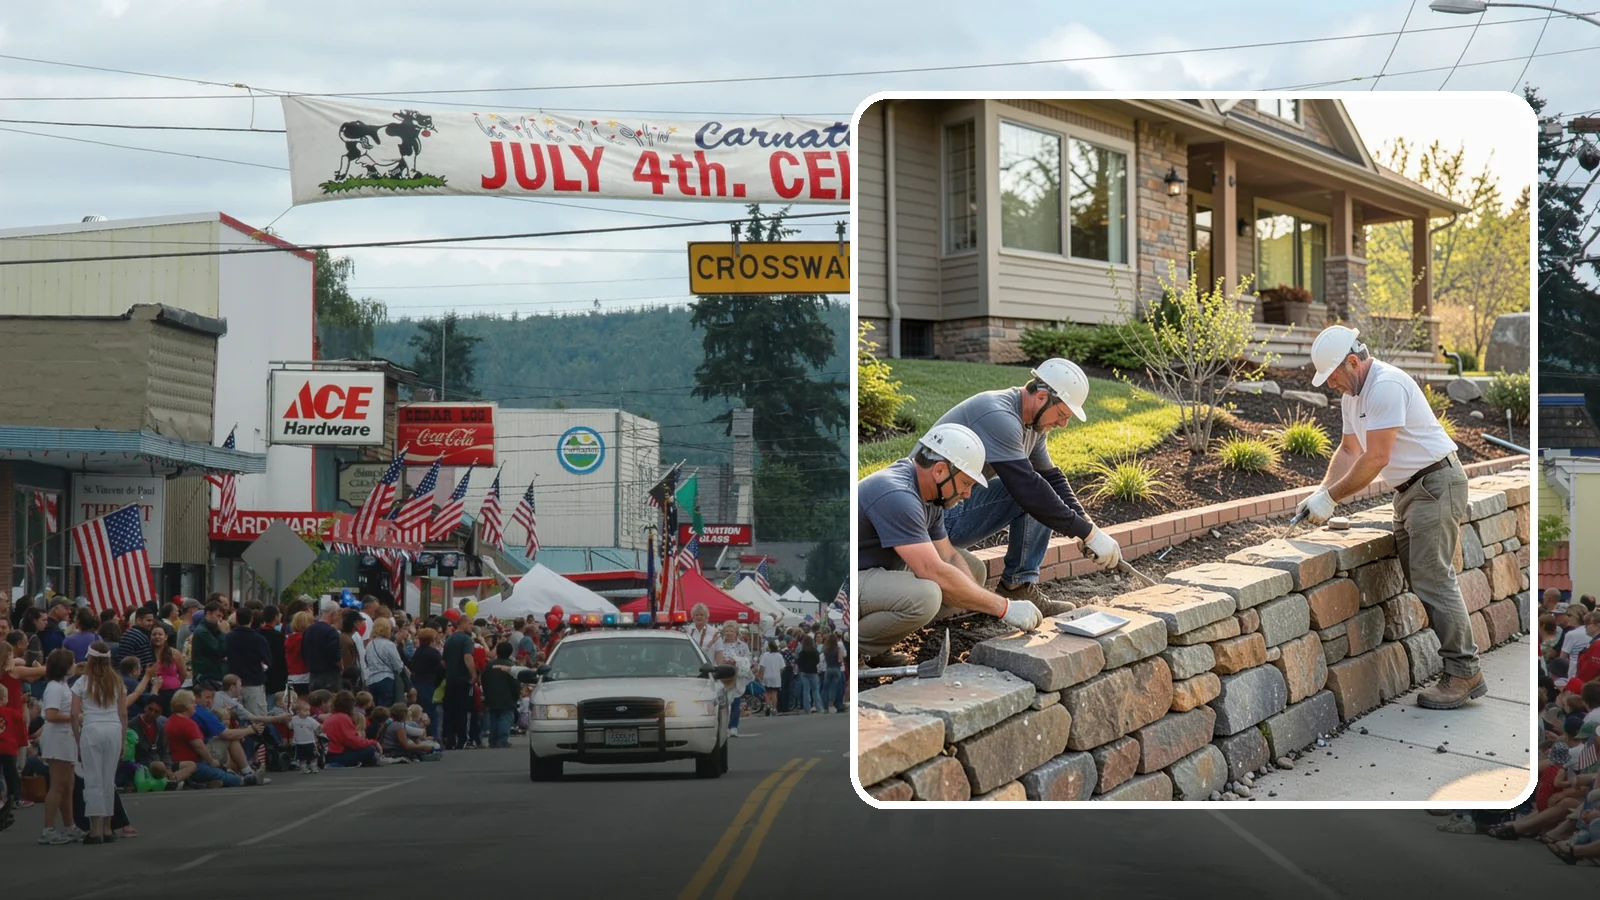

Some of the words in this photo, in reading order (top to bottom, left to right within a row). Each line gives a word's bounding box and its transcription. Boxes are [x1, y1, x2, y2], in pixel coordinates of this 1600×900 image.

[481, 140, 605, 192] JULY
[632, 150, 746, 197] 4th.
[696, 253, 850, 280] CROSSWA
[282, 379, 374, 420] ACE
[405, 408, 453, 422] CEDAR
[461, 408, 485, 421] LOG
[283, 421, 371, 436] Hardware
[416, 427, 477, 447] Coca-Cola
[353, 467, 387, 480] Simpl
[95, 485, 124, 495] Vincent
[126, 486, 136, 495] de
[137, 485, 156, 495] Paul
[688, 526, 742, 535] CRNATION
[699, 535, 730, 543] GLASS
